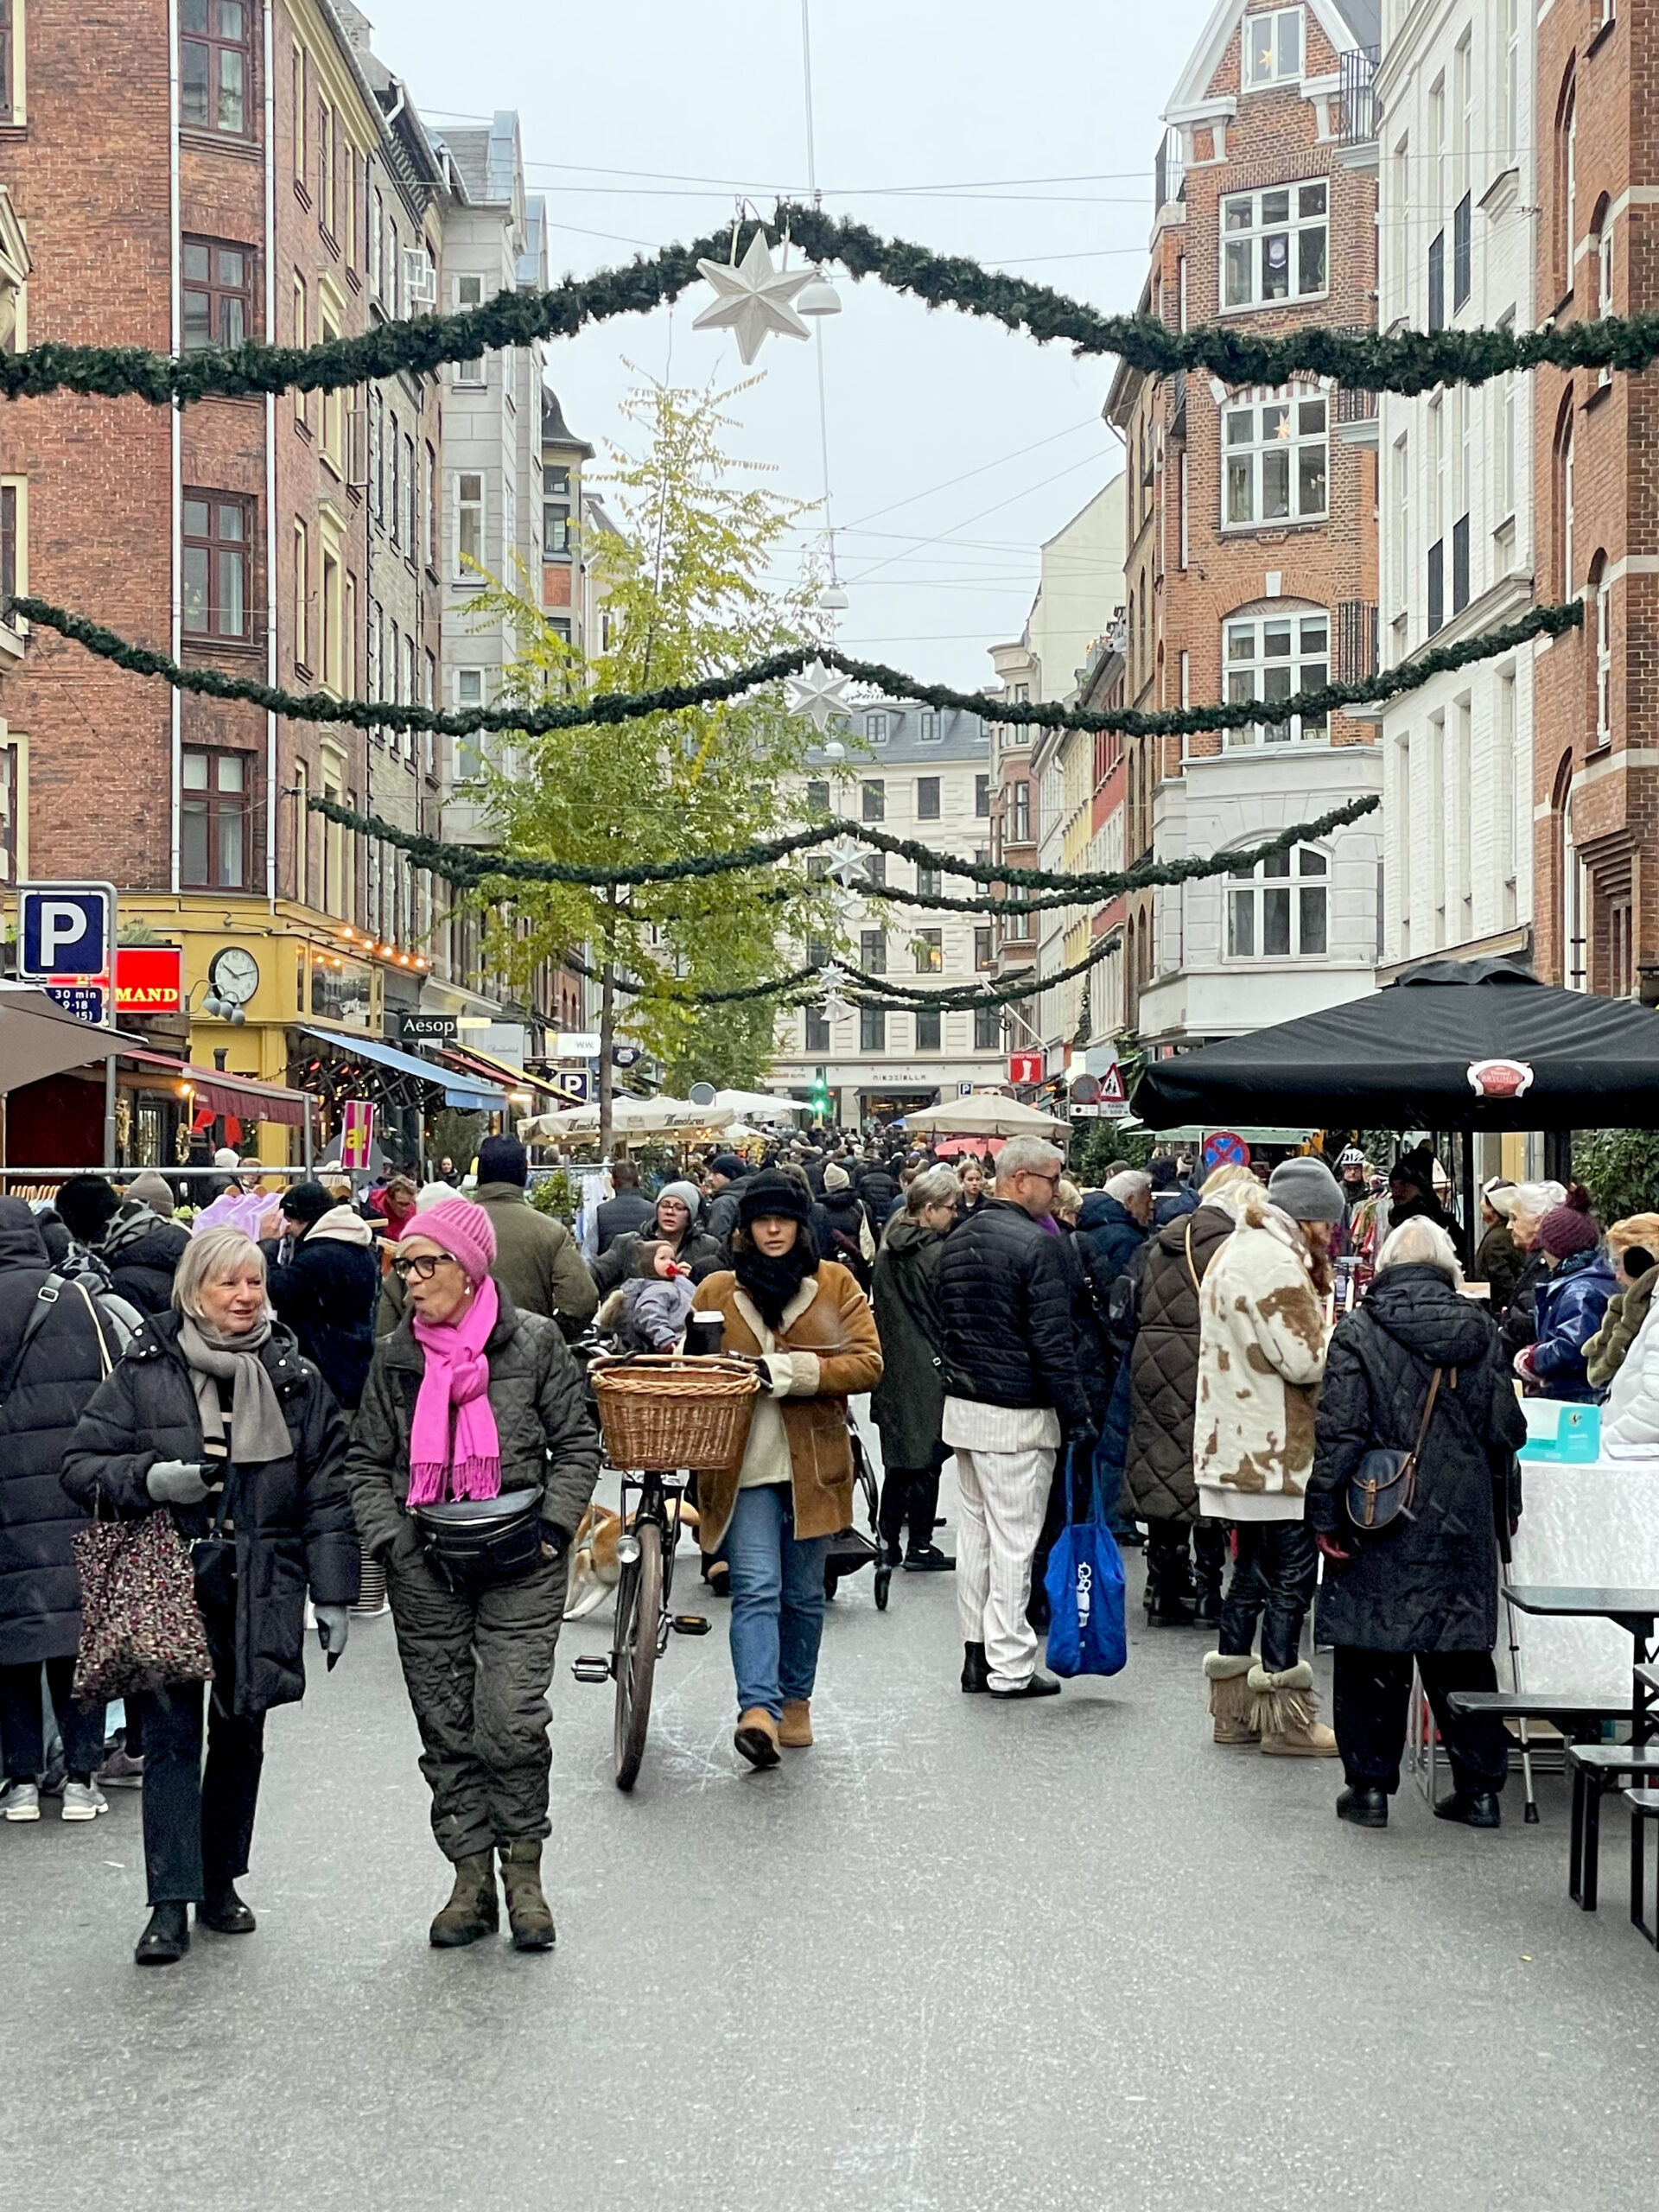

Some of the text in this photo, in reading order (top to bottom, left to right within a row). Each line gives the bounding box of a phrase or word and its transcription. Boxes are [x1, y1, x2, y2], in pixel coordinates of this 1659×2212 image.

[41, 902, 87, 967] P
[54, 989, 97, 999] 30 min
[105, 988, 178, 1001] MAND
[76, 1012, 92, 1021] 15)
[565, 1075, 582, 1094] P
[962, 1084, 970, 1095] P
